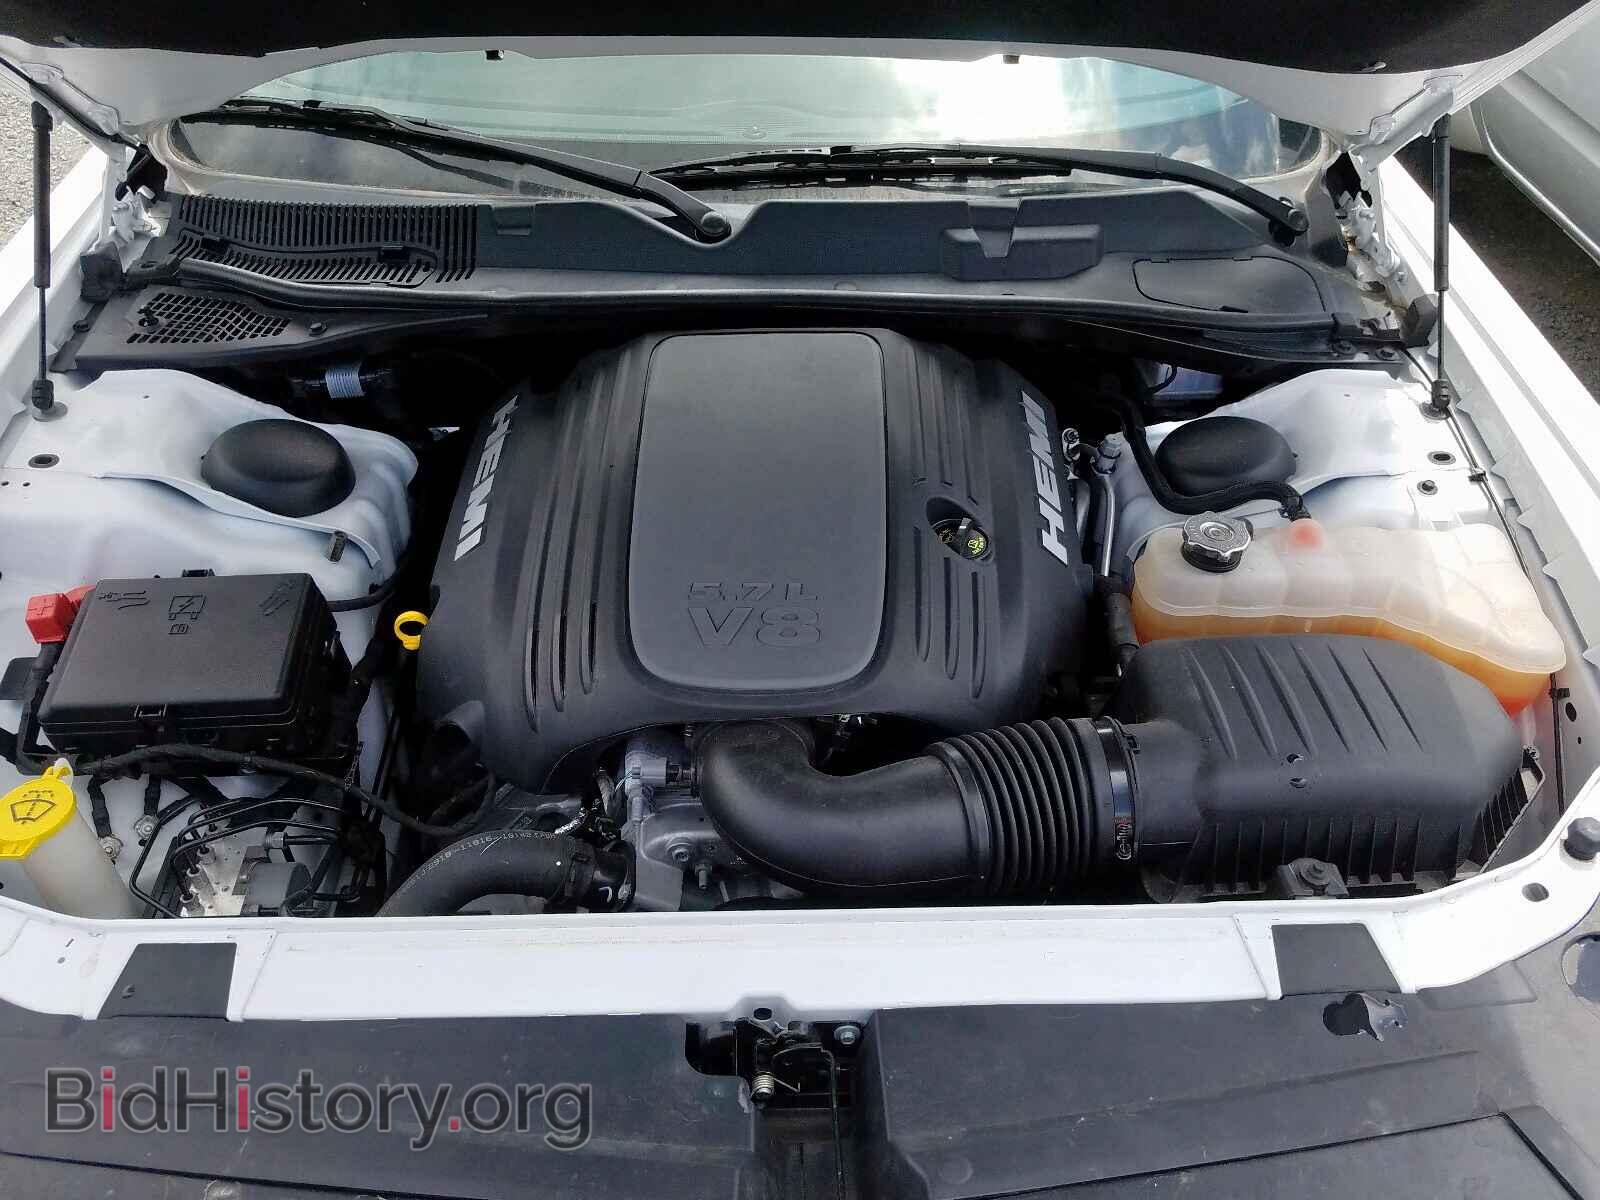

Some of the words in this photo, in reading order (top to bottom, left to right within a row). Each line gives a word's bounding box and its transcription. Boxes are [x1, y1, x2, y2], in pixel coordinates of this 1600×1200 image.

[454, 394, 518, 562] HEMI
[1021, 390, 1069, 566] HEMI
[687, 607, 822, 647] V8
